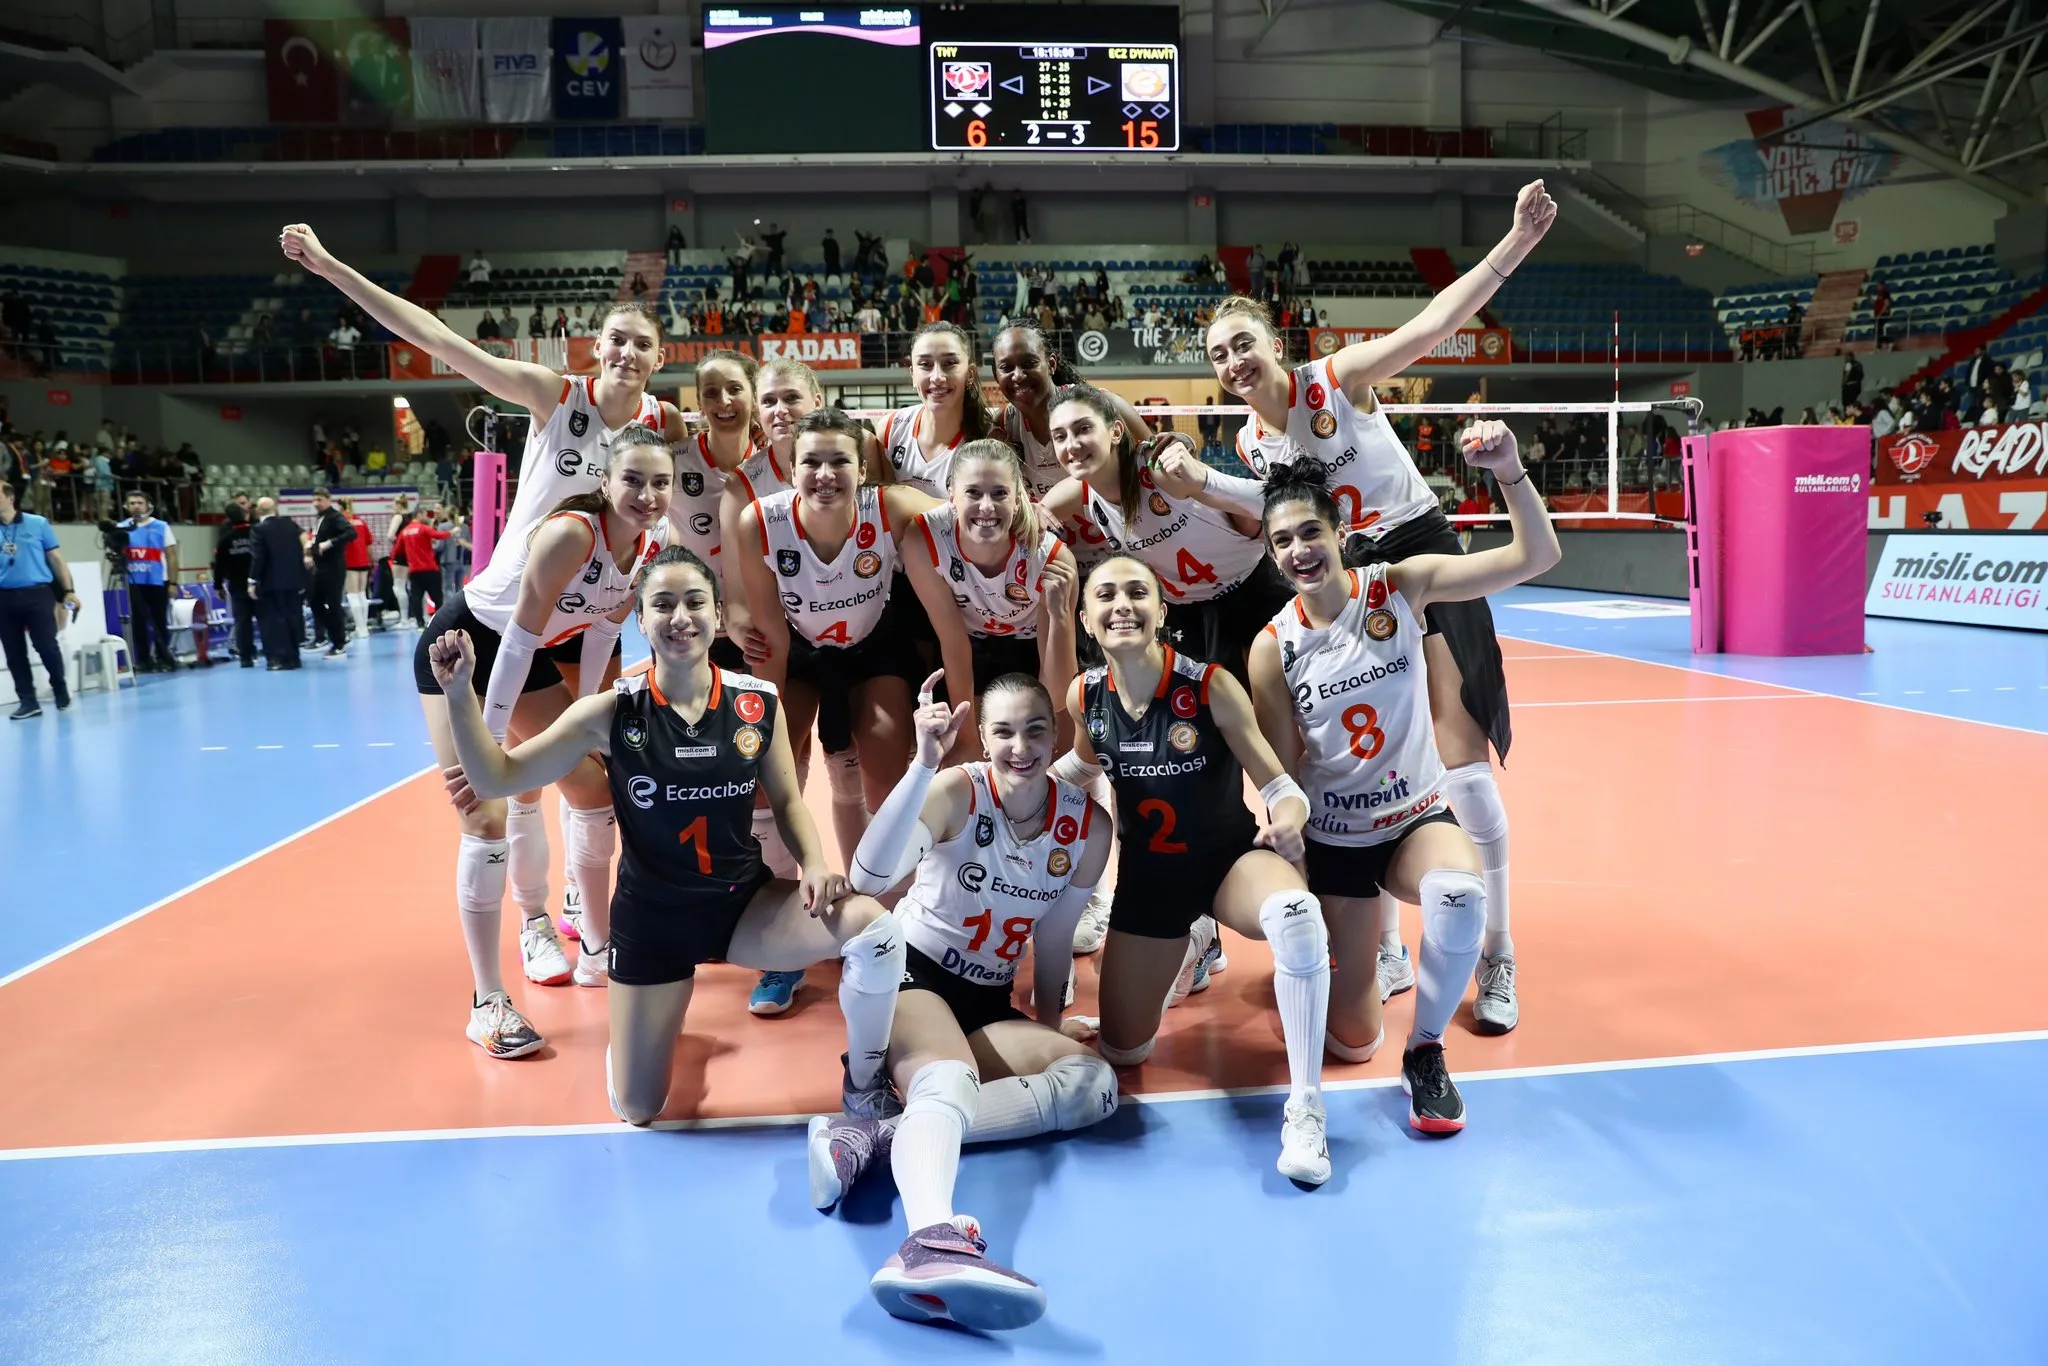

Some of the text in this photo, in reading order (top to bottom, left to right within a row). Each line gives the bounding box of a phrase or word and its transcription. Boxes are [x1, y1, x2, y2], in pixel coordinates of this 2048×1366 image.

[493, 54, 536, 70] FIVB
[566, 80, 610, 97] CEV
[967, 120, 987, 147] 6
[1027, 123, 1041, 144] 2
[1071, 123, 1086, 145] 3
[1122, 120, 1159, 148] 15
[761, 338, 858, 361] KADAR
[1132, 328, 1163, 348] THE
[1795, 474, 1850, 486] misli.com
[130, 549, 147, 559] TV
[1892, 552, 2048, 585] misli.com
[809, 580, 883, 613] Eczacıbaşı
[816, 620, 853, 644] 4
[1317, 655, 1410, 700] Eczacıbaşı
[1341, 703, 1386, 760] 8
[1119, 755, 1207, 778] Eczacıbaşı
[1137, 798, 1188, 854] 2
[679, 815, 713, 875] 1
[962, 908, 1036, 960] 18
[611, 947, 617, 970] 1
